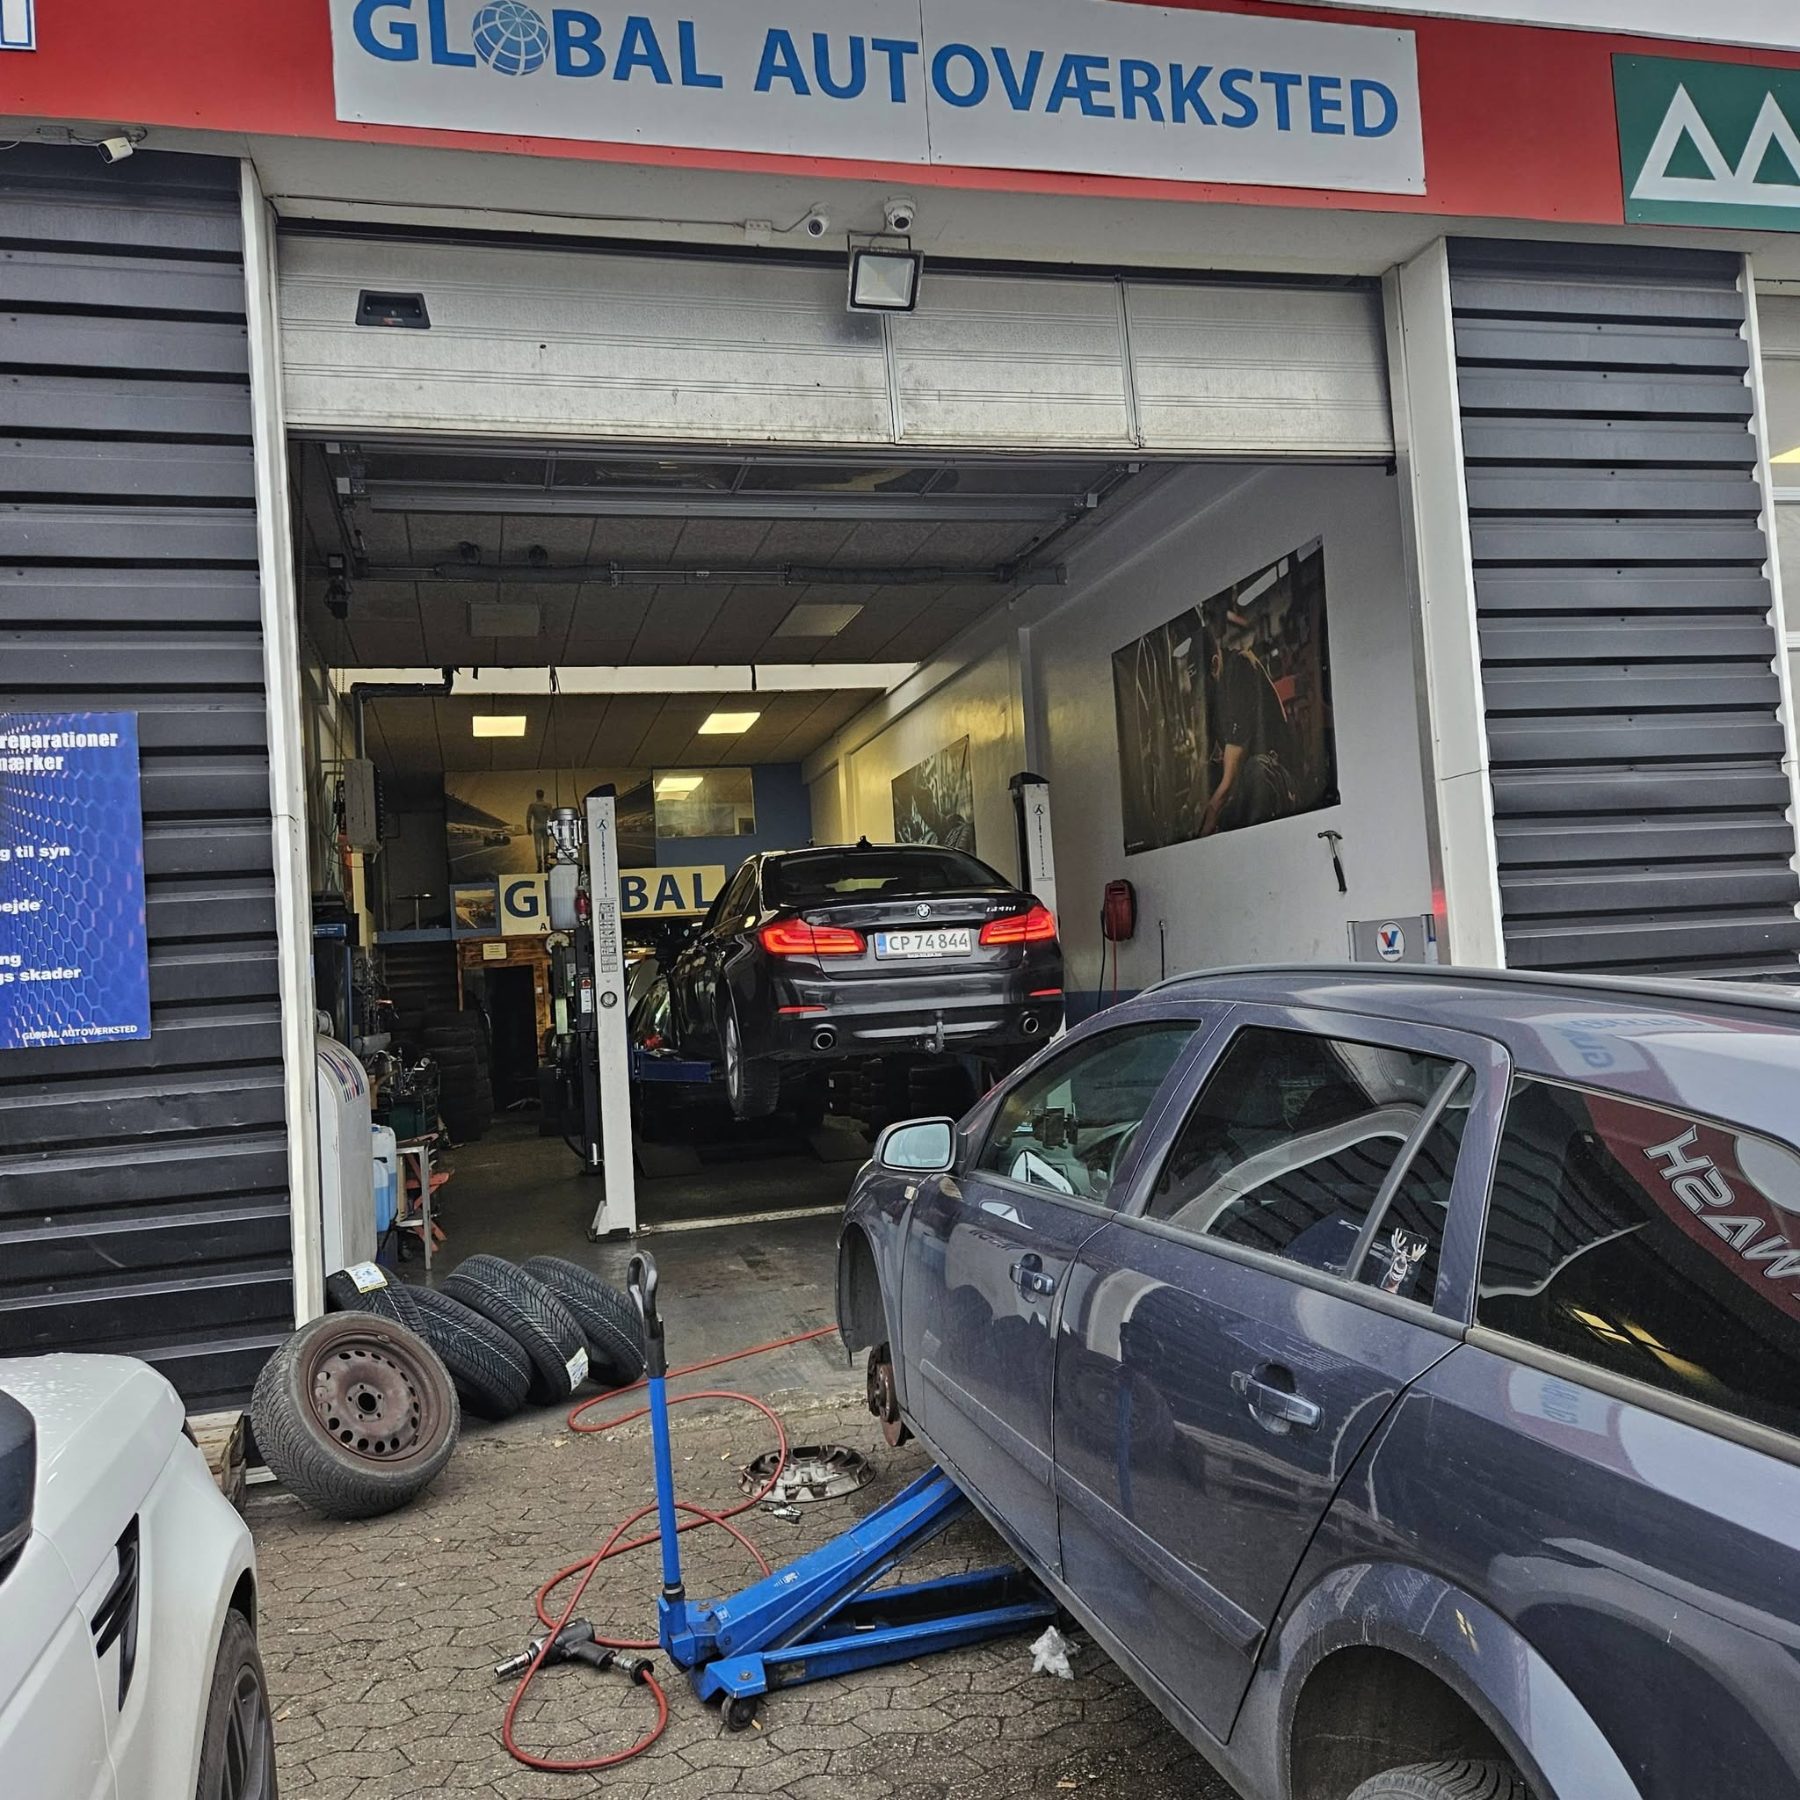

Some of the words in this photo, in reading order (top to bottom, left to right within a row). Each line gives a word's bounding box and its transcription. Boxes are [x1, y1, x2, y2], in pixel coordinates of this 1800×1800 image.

[352, 0, 723, 89] GLOBAL
[753, 28, 1399, 138] AUTOVÆRKSTED
[15, 845, 35, 858] til
[39, 846, 71, 860] syn
[504, 873, 714, 918] GBAL
[0, 898, 41, 915] ejde
[889, 936, 910, 951] CP
[914, 934, 935, 950] 74
[938, 932, 968, 949] 844
[20, 967, 81, 982] skader
[22, 1030, 60, 1041] GLOBAL
[62, 1024, 138, 1038] AUTOVÆRKSTED
